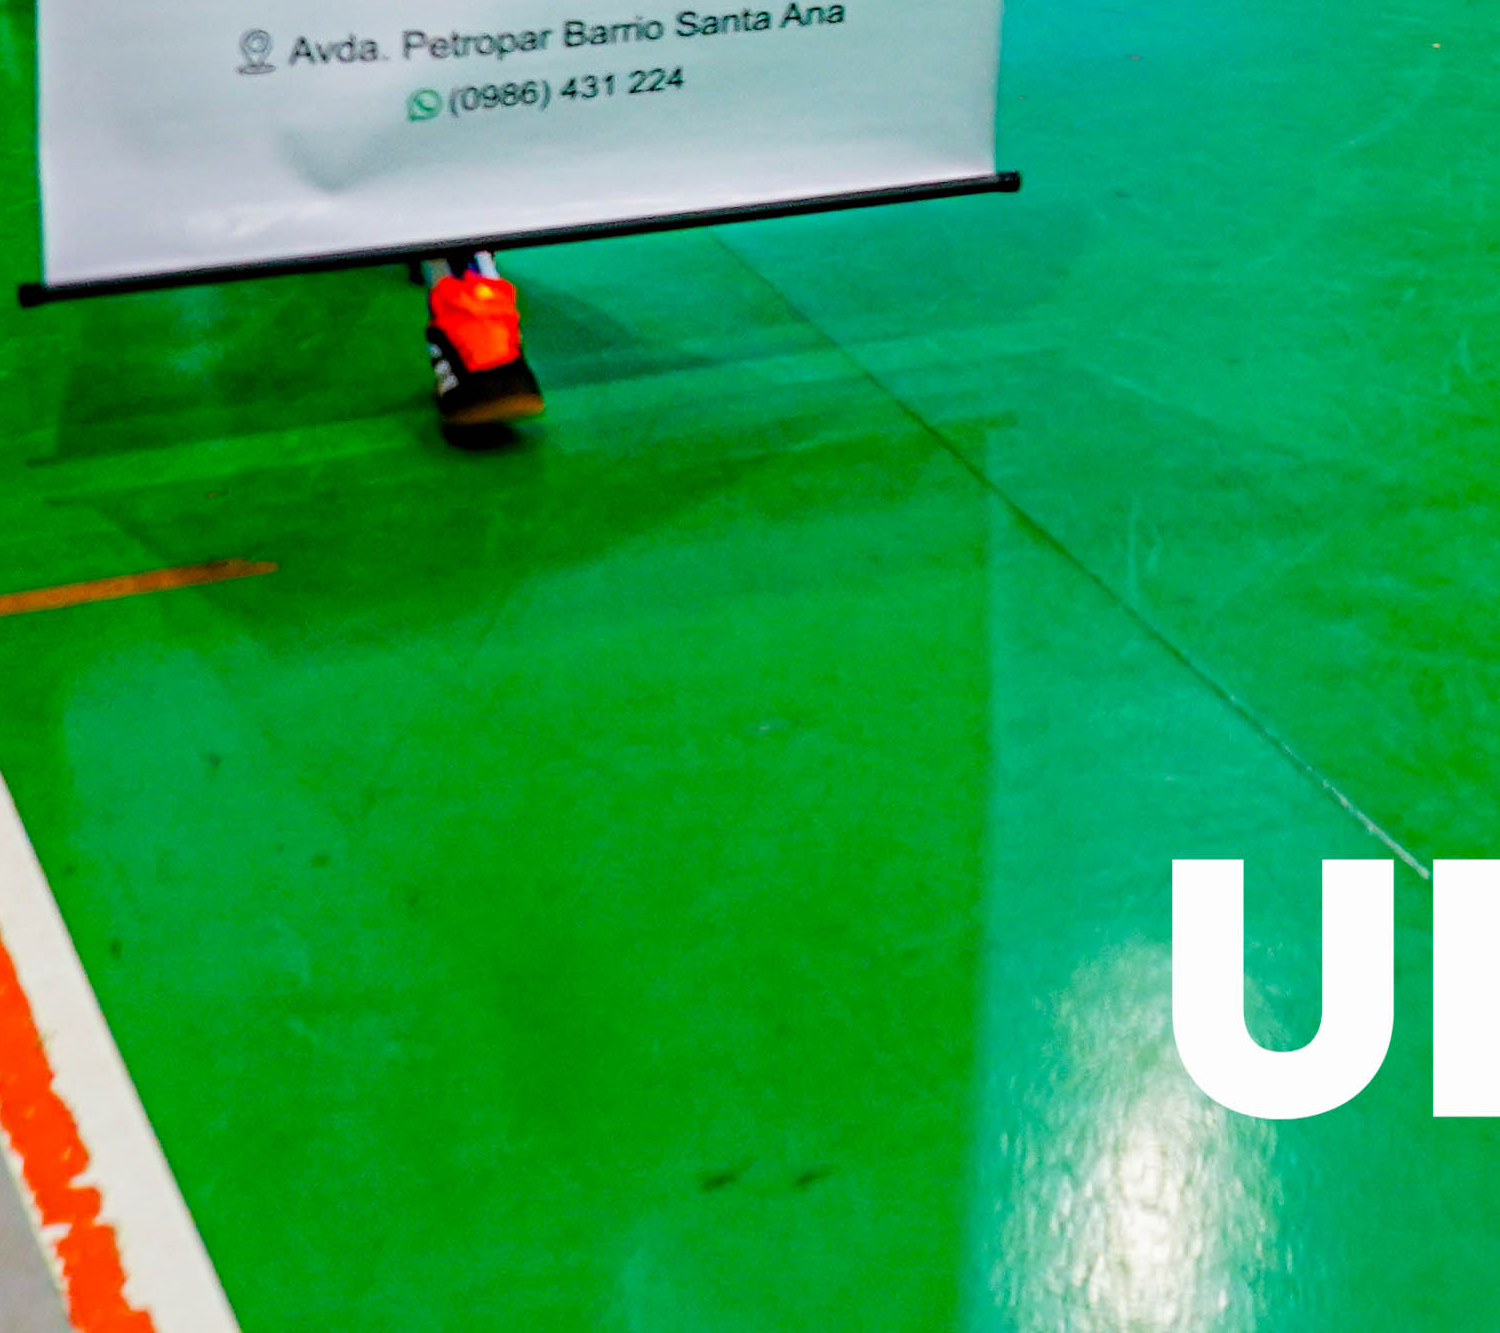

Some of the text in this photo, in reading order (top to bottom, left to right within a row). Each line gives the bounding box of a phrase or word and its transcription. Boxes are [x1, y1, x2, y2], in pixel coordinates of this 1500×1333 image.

[288, 0, 846, 68] Avda. Petropar Barrio Santa Ana
[449, 65, 686, 119] (0986) 431 224
